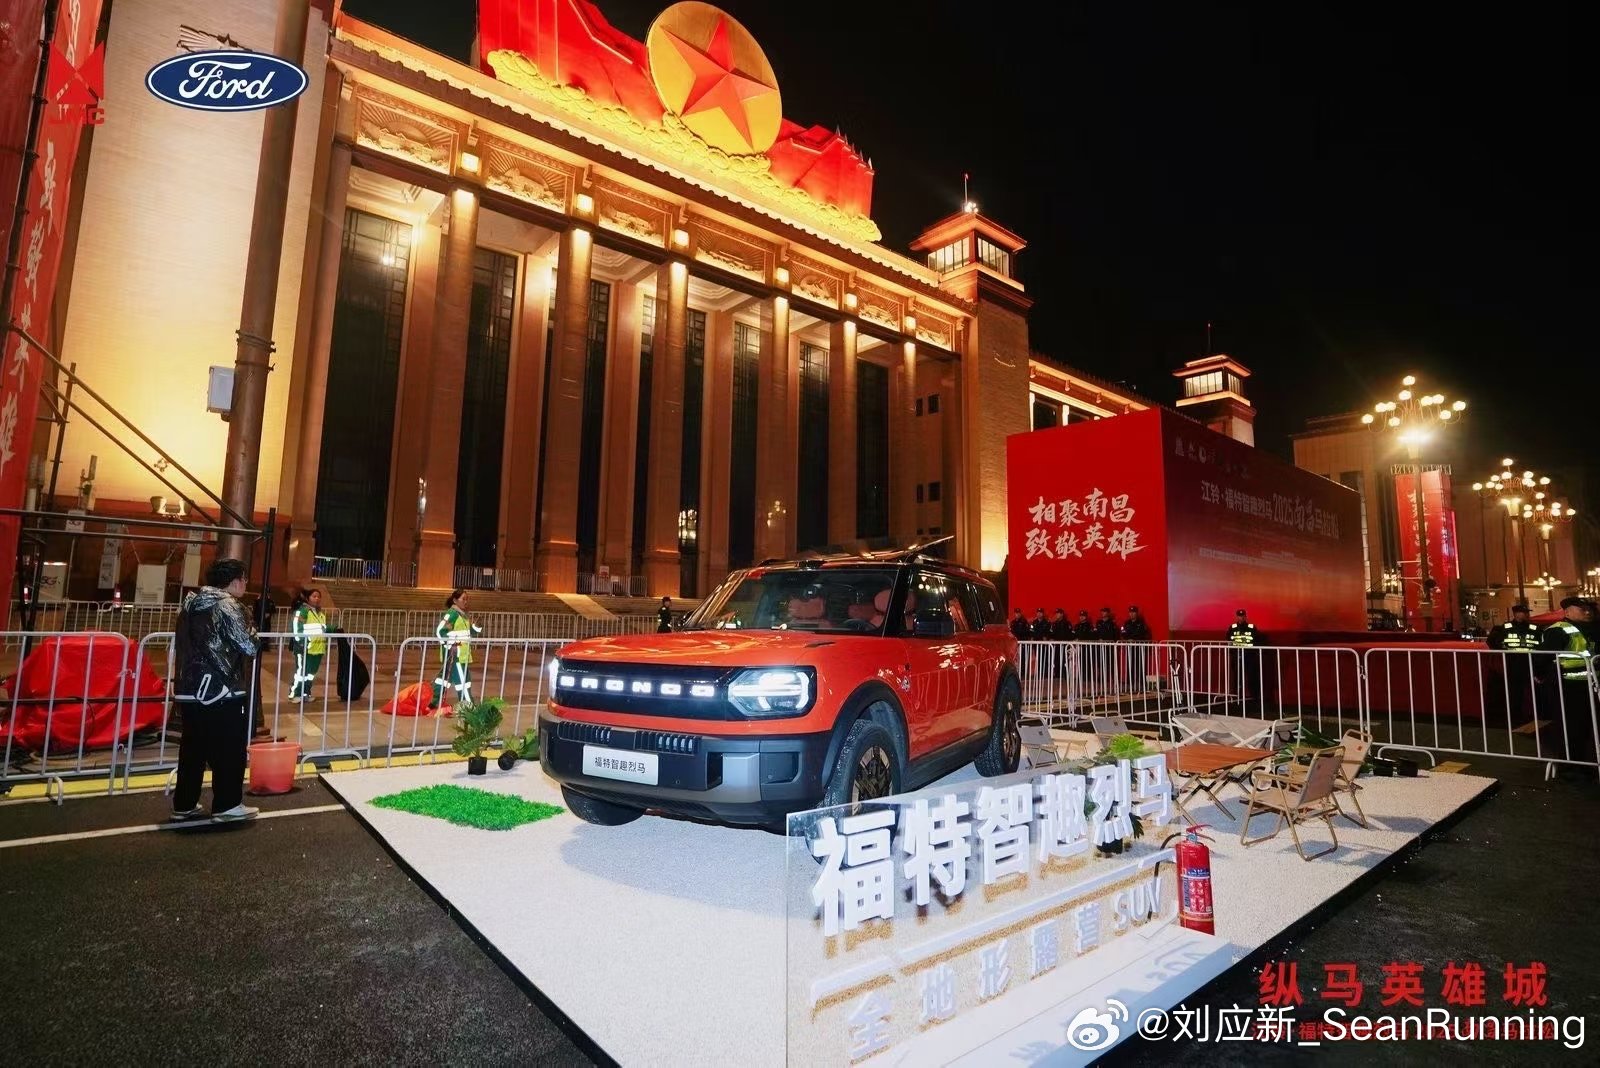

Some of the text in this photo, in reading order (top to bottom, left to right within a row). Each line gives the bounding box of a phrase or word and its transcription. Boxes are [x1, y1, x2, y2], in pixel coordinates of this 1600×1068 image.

[1029, 488, 1136, 528] 相聚南昌
[1026, 522, 1149, 561] 致敬英雄
[594, 757, 646, 774] 福特智趣烈马
[812, 753, 1173, 937] 福特智趣烈马
